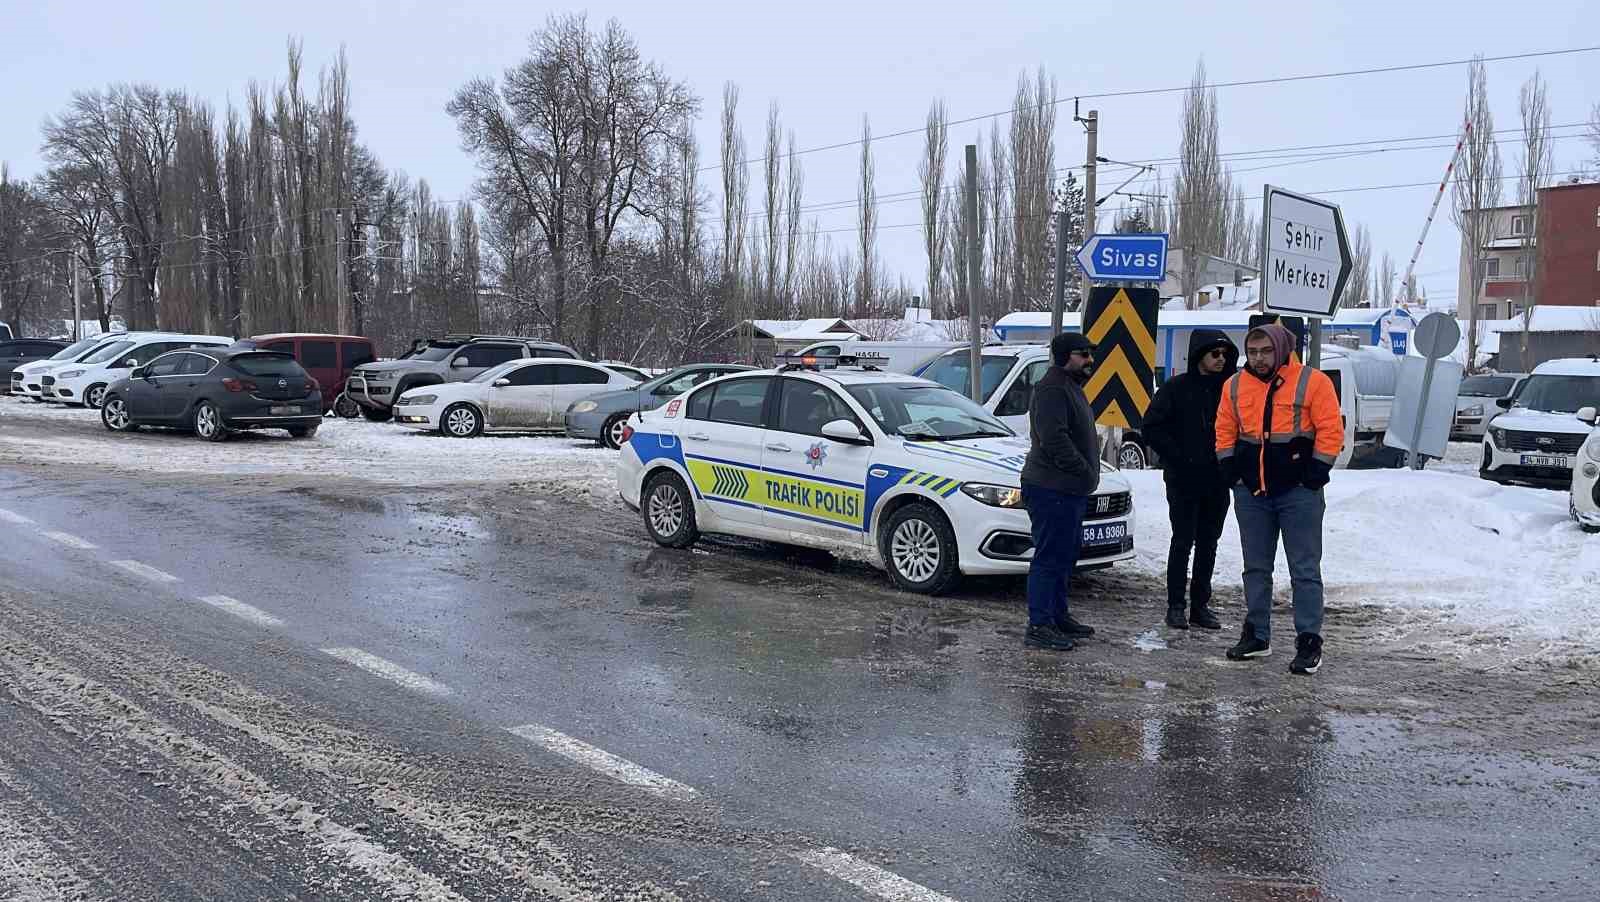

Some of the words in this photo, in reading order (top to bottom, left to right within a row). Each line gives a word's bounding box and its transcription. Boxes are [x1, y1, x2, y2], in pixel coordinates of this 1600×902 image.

[1285, 220, 1324, 252] Şehir
[1100, 247, 1159, 268] Sivas
[1274, 258, 1332, 289] Merkezi
[765, 479, 812, 508] TRAFİK
[815, 489, 859, 518] POLİSİ
[1096, 496, 1110, 513] FIAT
[1083, 527, 1095, 541] 58
[1097, 528, 1105, 540] A
